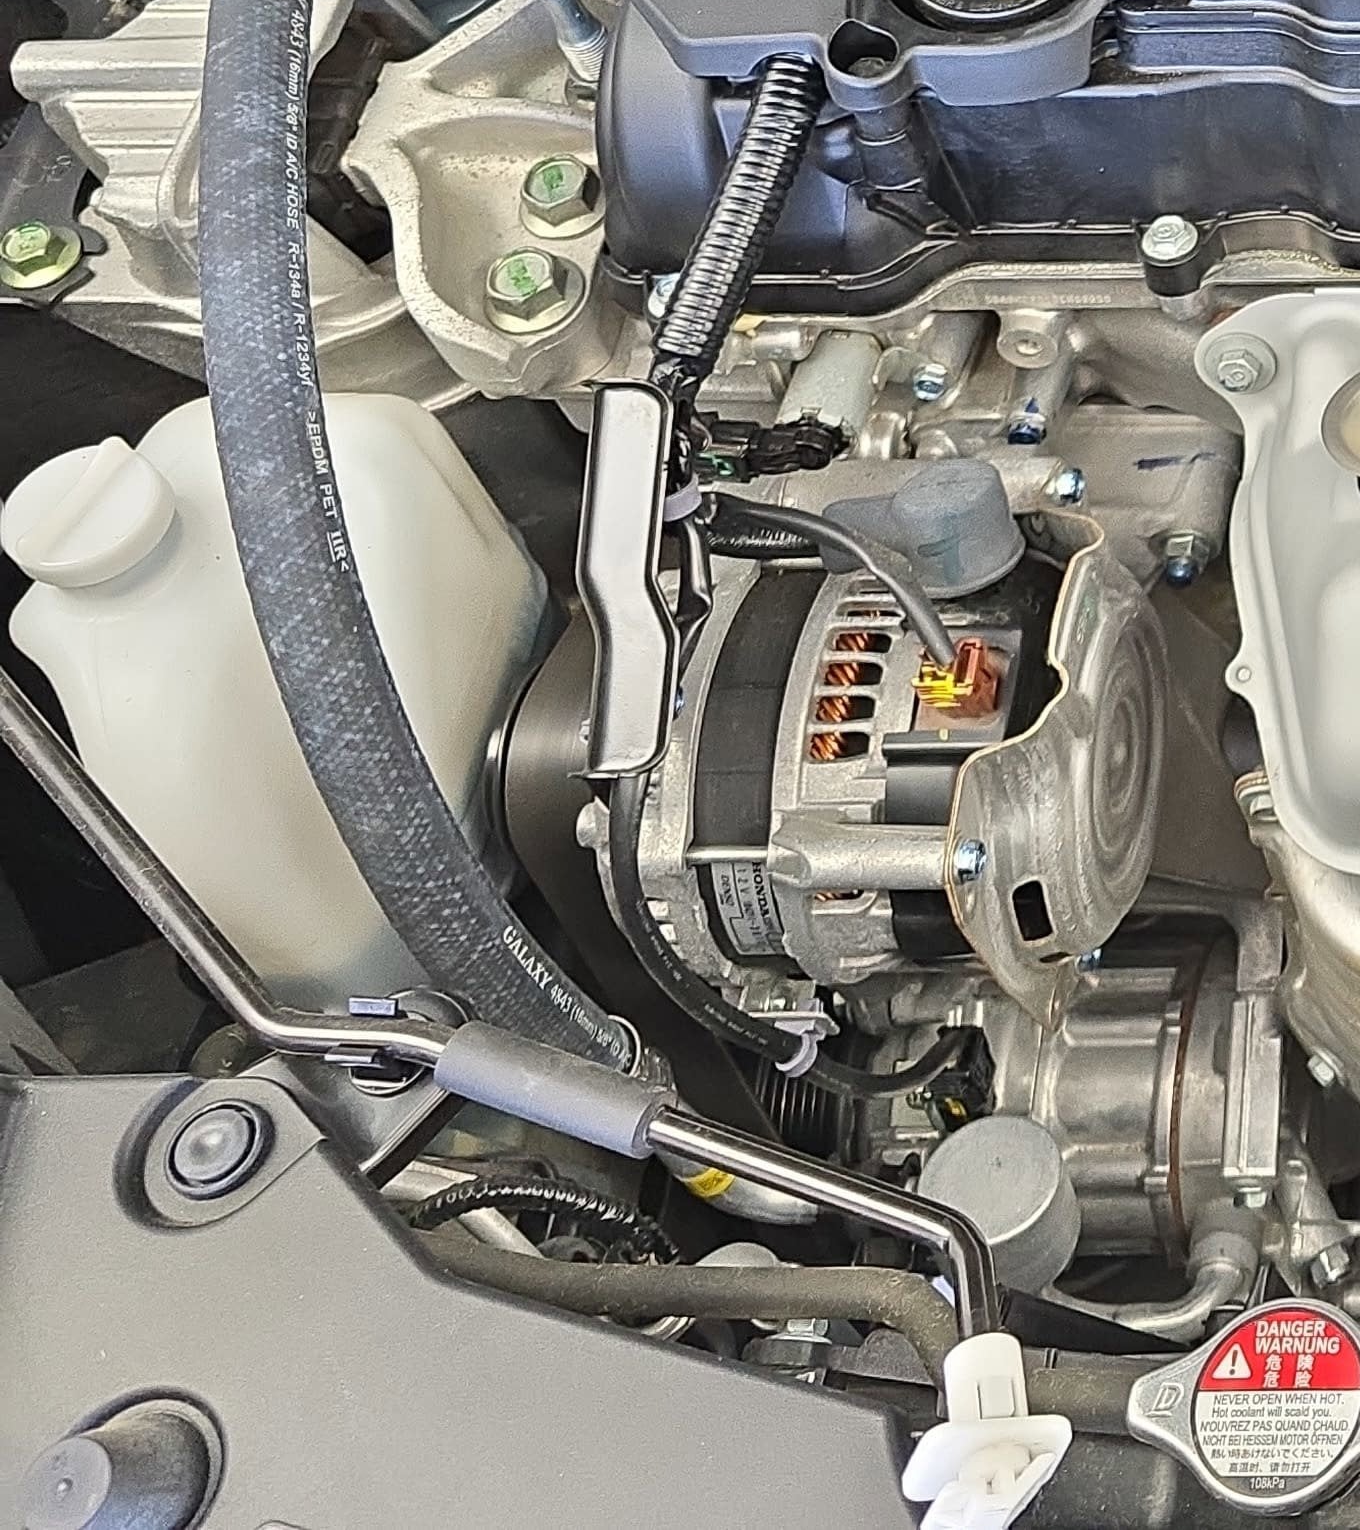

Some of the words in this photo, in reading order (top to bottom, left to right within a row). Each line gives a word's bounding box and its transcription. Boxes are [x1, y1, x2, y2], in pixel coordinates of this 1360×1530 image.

[290, 7, 306, 50] 4843
[284, 50, 303, 102] (16mm)
[285, 152, 298, 180] A/C
[285, 182, 299, 230] HOSE
[287, 240, 302, 300] R-134a
[292, 314, 315, 388] R-1234yf
[320, 483, 339, 520] PET
[752, 861, 770, 918] HONDA
[503, 925, 553, 990] GALAXY
[550, 983, 573, 1013] 4843
[1256, 1320, 1326, 1337] DANGER
[1255, 1336, 1340, 1354] WARNUNG
[1212, 1407, 1228, 1419] Hot
[1230, 1406, 1265, 1418] coolant
[1267, 1406, 1282, 1417] will
[1284, 1406, 1310, 1418] scald
[1311, 1408, 1332, 1420] you.
[1213, 1393, 1250, 1405] NEVER
[1252, 1393, 1282, 1405] OPEN
[1285, 1393, 1317, 1405] WHEN
[1319, 1393, 1345, 1405] HOT.
[1200, 1420, 1250, 1432] N'OUVREZ
[1252, 1420, 1273, 1432] PAS
[1275, 1420, 1311, 1432] QUAND
[1202, 1434, 1227, 1446] NICHT
[1228, 1434, 1241, 1446] BEI
[1242, 1434, 1278, 1446] HEISSEM
[1279, 1434, 1309, 1446] MOTOR
[1250, 1477, 1286, 1490] 108kPa
